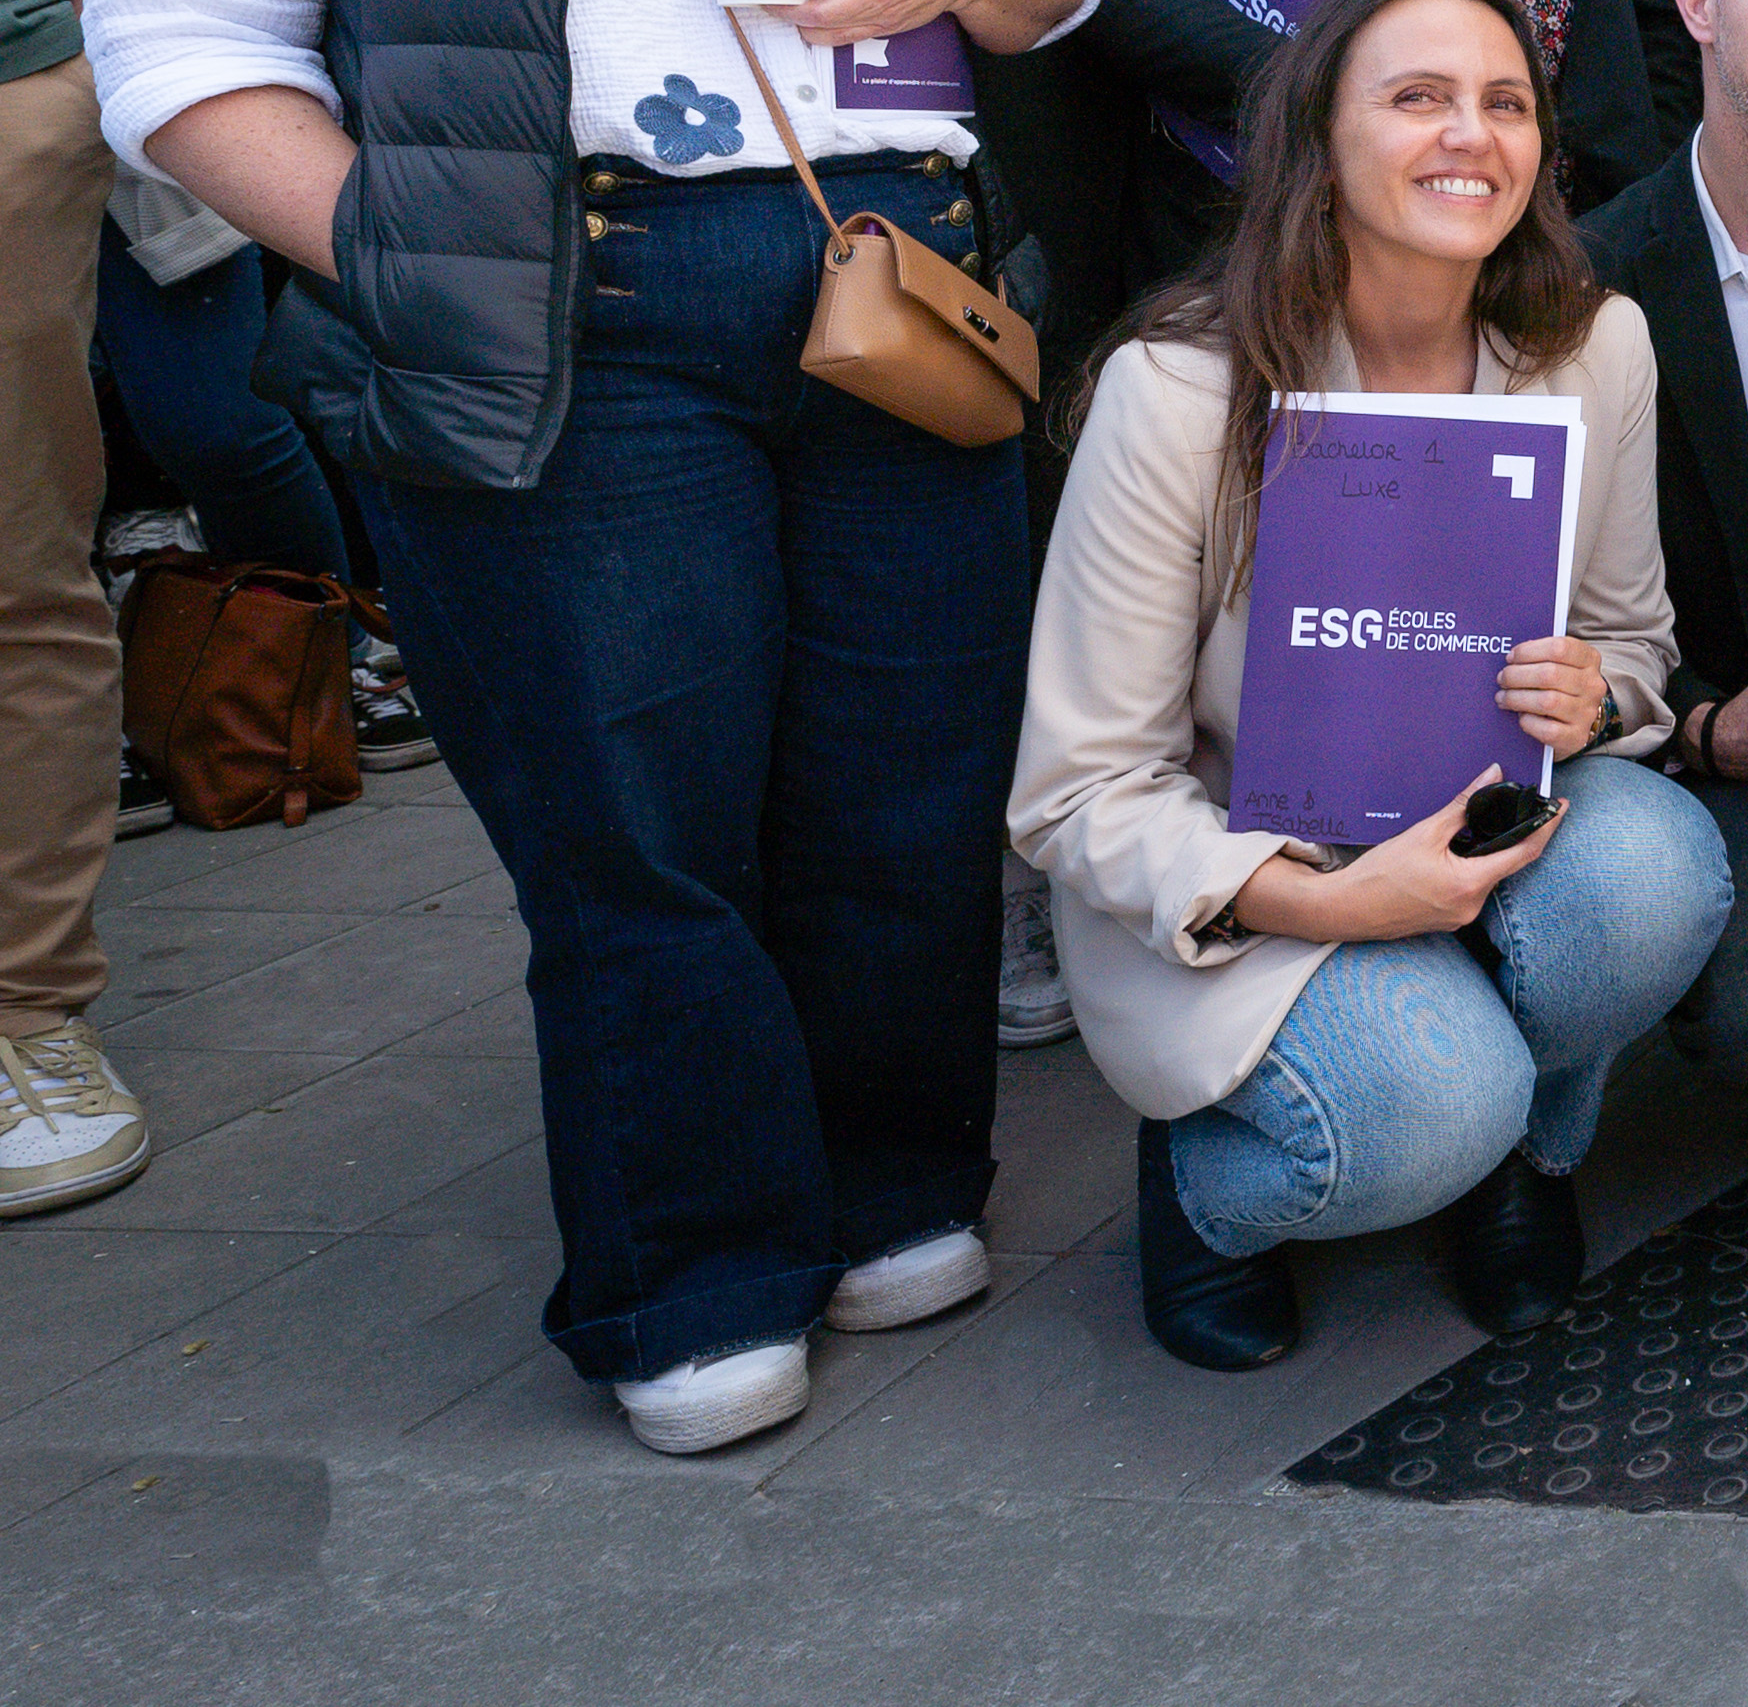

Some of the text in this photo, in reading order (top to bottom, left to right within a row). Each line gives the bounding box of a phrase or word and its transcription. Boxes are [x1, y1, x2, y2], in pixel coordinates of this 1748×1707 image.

[1424, 439, 1444, 464] 1
[1342, 473, 1401, 500] Luxe
[1290, 606, 1456, 649] ESG ÉCOLES
[1385, 632, 1513, 654] DE COMMERCE
[1244, 790, 1289, 810] Anne
[1247, 812, 1350, 839] Isabelle
